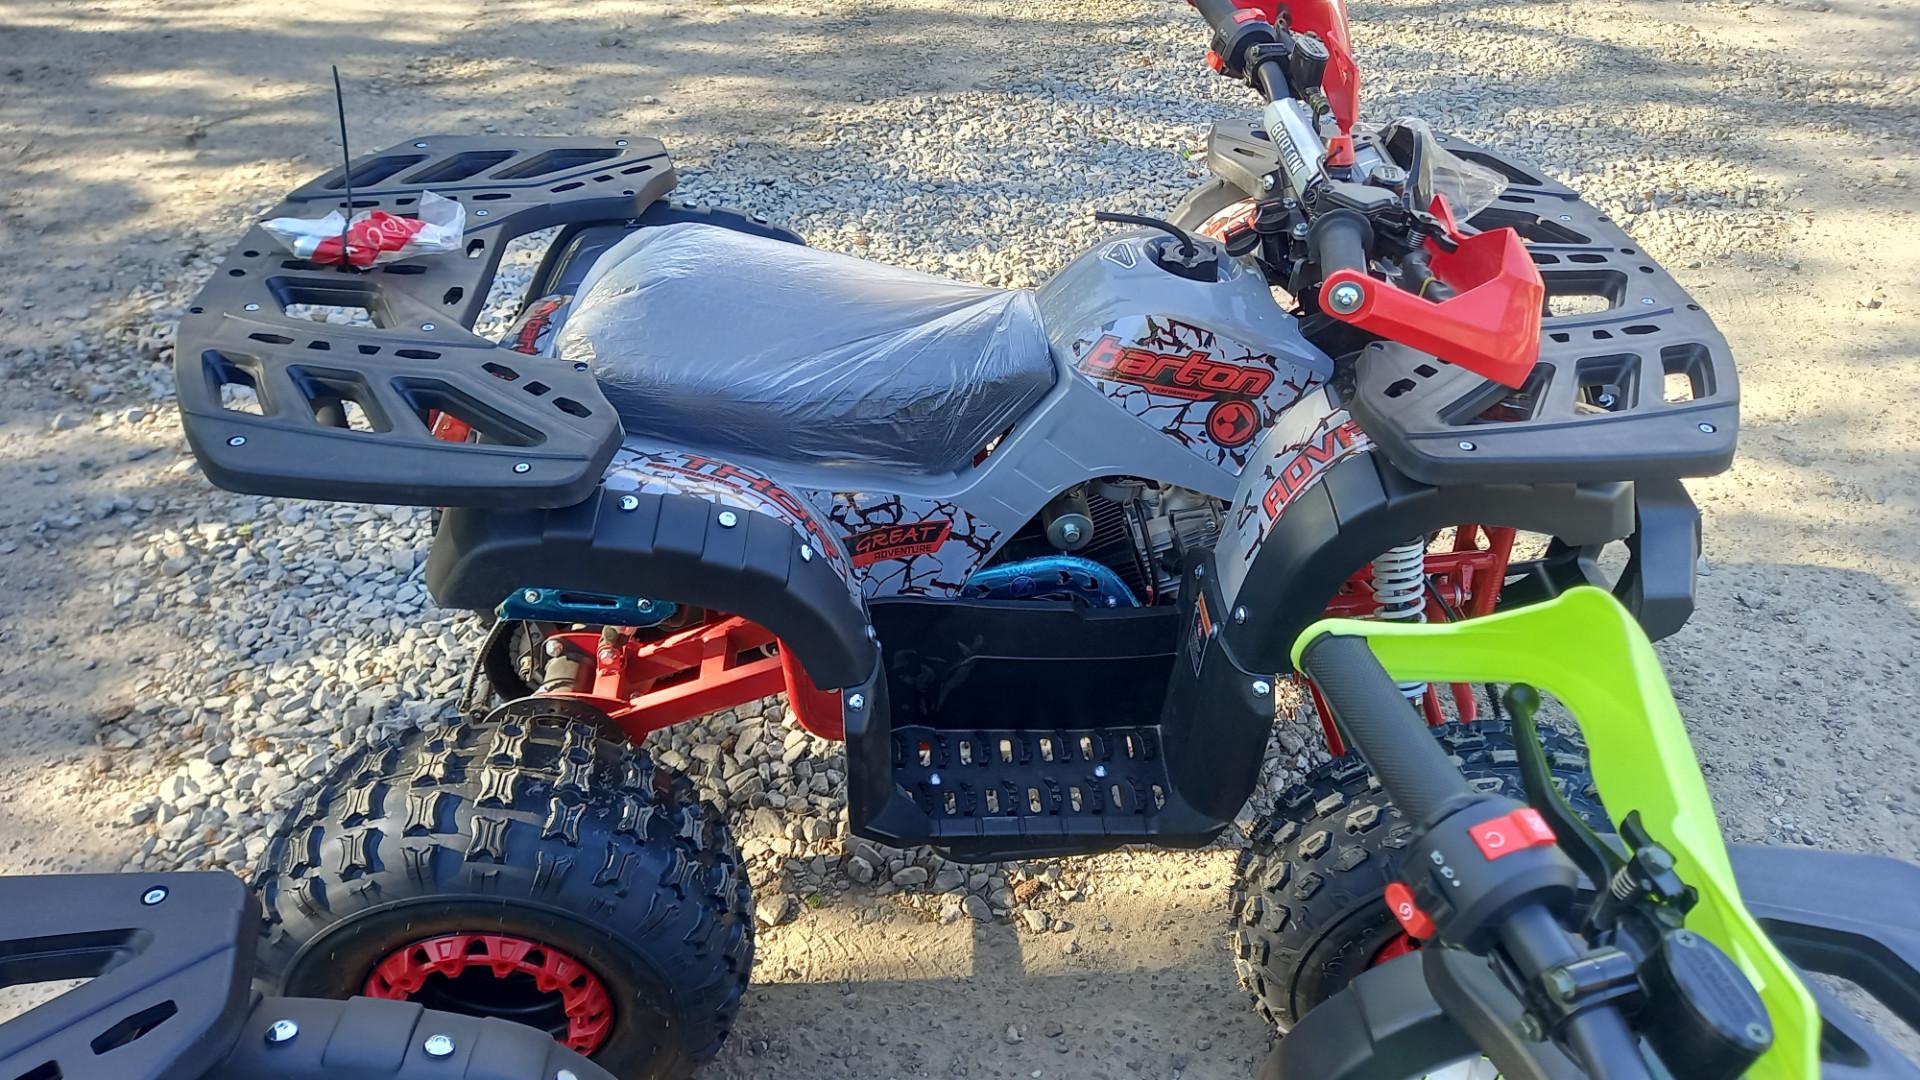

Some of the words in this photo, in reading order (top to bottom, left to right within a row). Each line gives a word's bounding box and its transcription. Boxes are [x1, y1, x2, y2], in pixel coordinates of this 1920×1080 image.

[1271, 120, 1305, 177] BARTON
[1084, 334, 1275, 396] barton
[855, 524, 938, 554] GREAT
[873, 542, 933, 561] ADVENTURE
